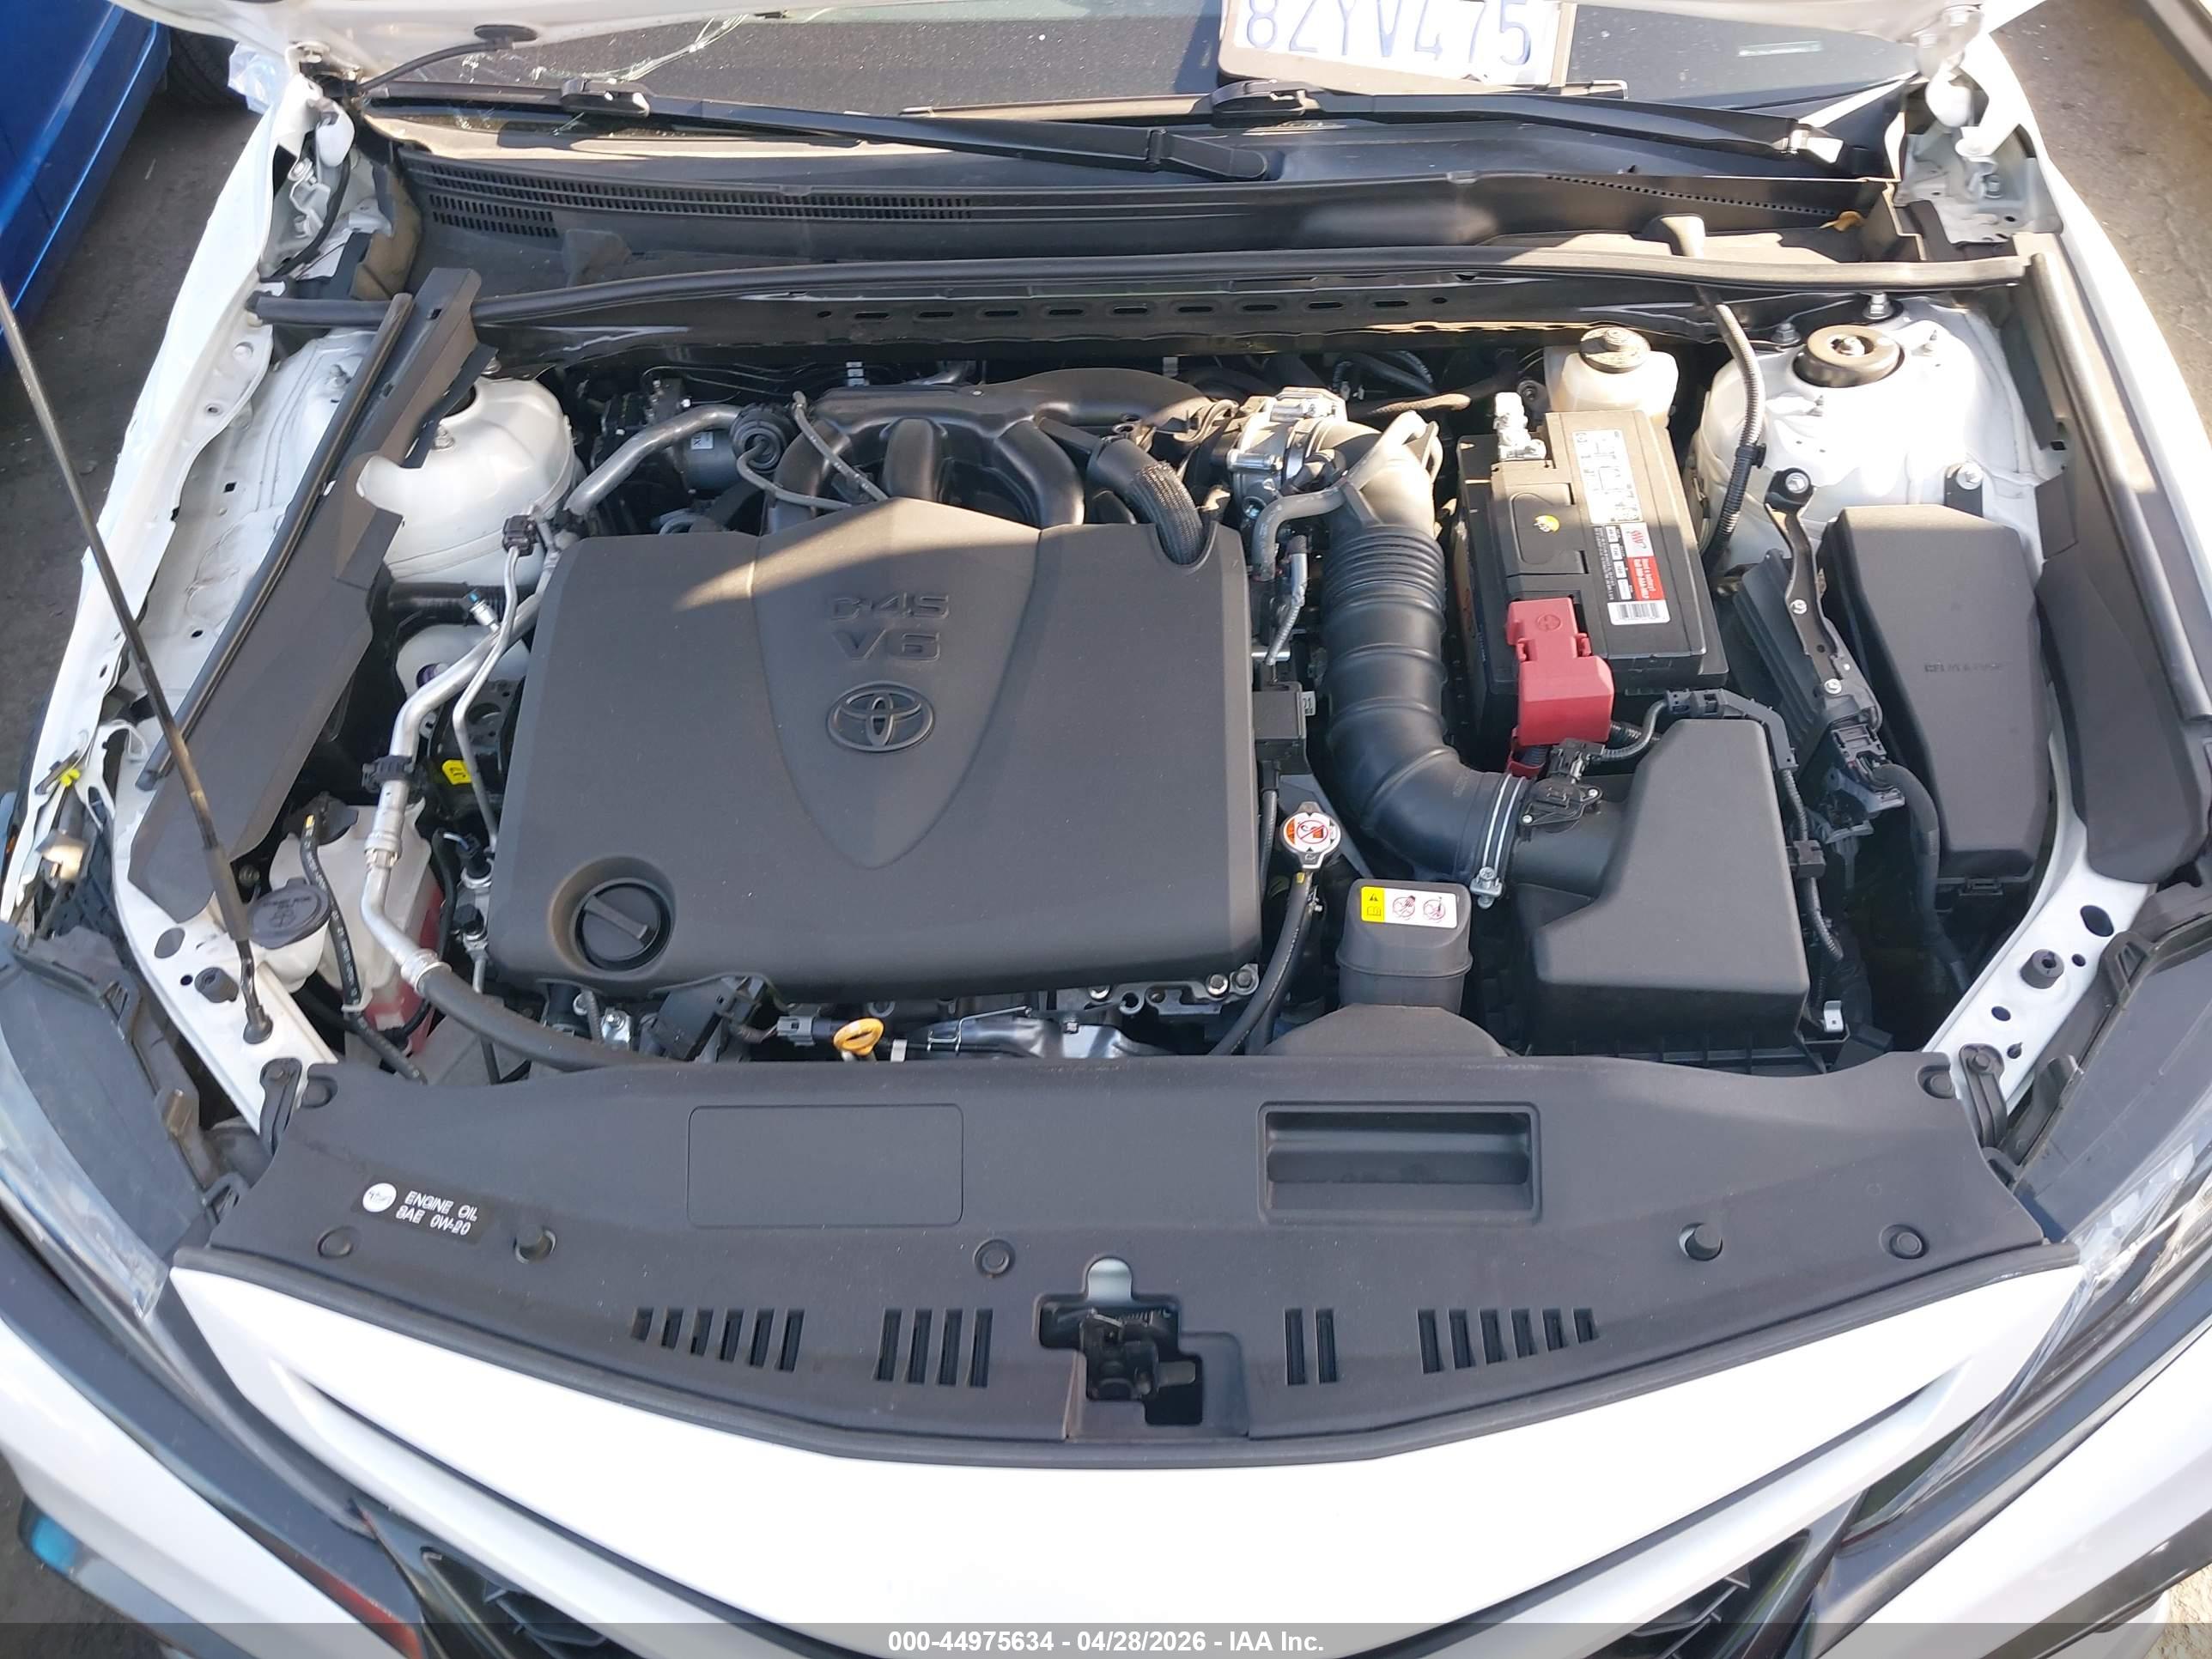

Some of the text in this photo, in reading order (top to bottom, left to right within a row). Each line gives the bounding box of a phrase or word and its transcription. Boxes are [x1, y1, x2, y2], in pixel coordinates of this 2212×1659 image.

[831, 628, 941, 663] V6
[395, 1205, 471, 1237] SAE 0W-20
[404, 1190, 478, 1222] ENGINE OIL
